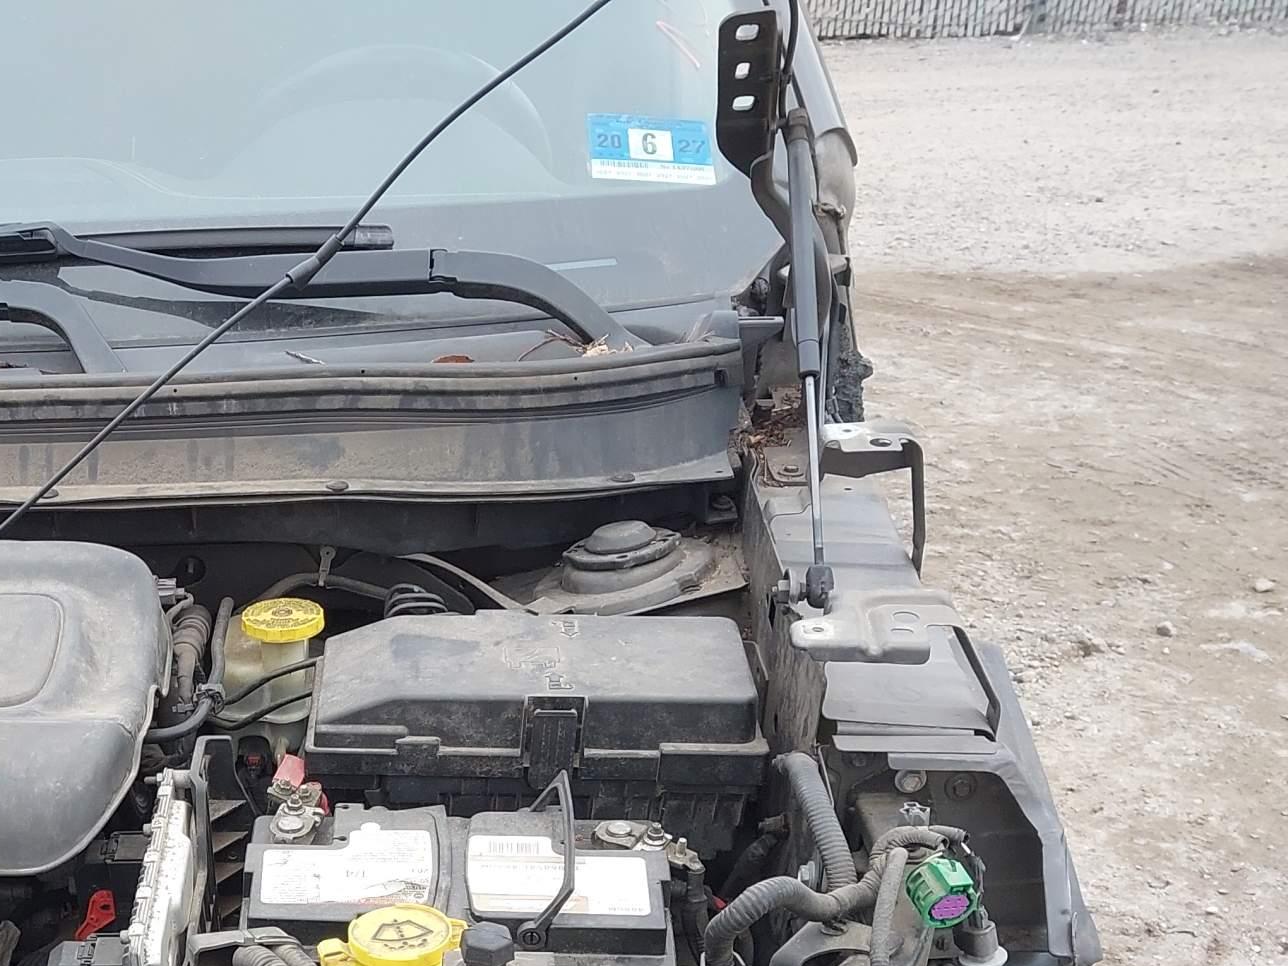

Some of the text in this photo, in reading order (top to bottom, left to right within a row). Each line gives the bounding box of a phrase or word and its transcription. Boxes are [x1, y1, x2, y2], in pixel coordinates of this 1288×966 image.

[597, 133, 705, 155] 20 6 27
